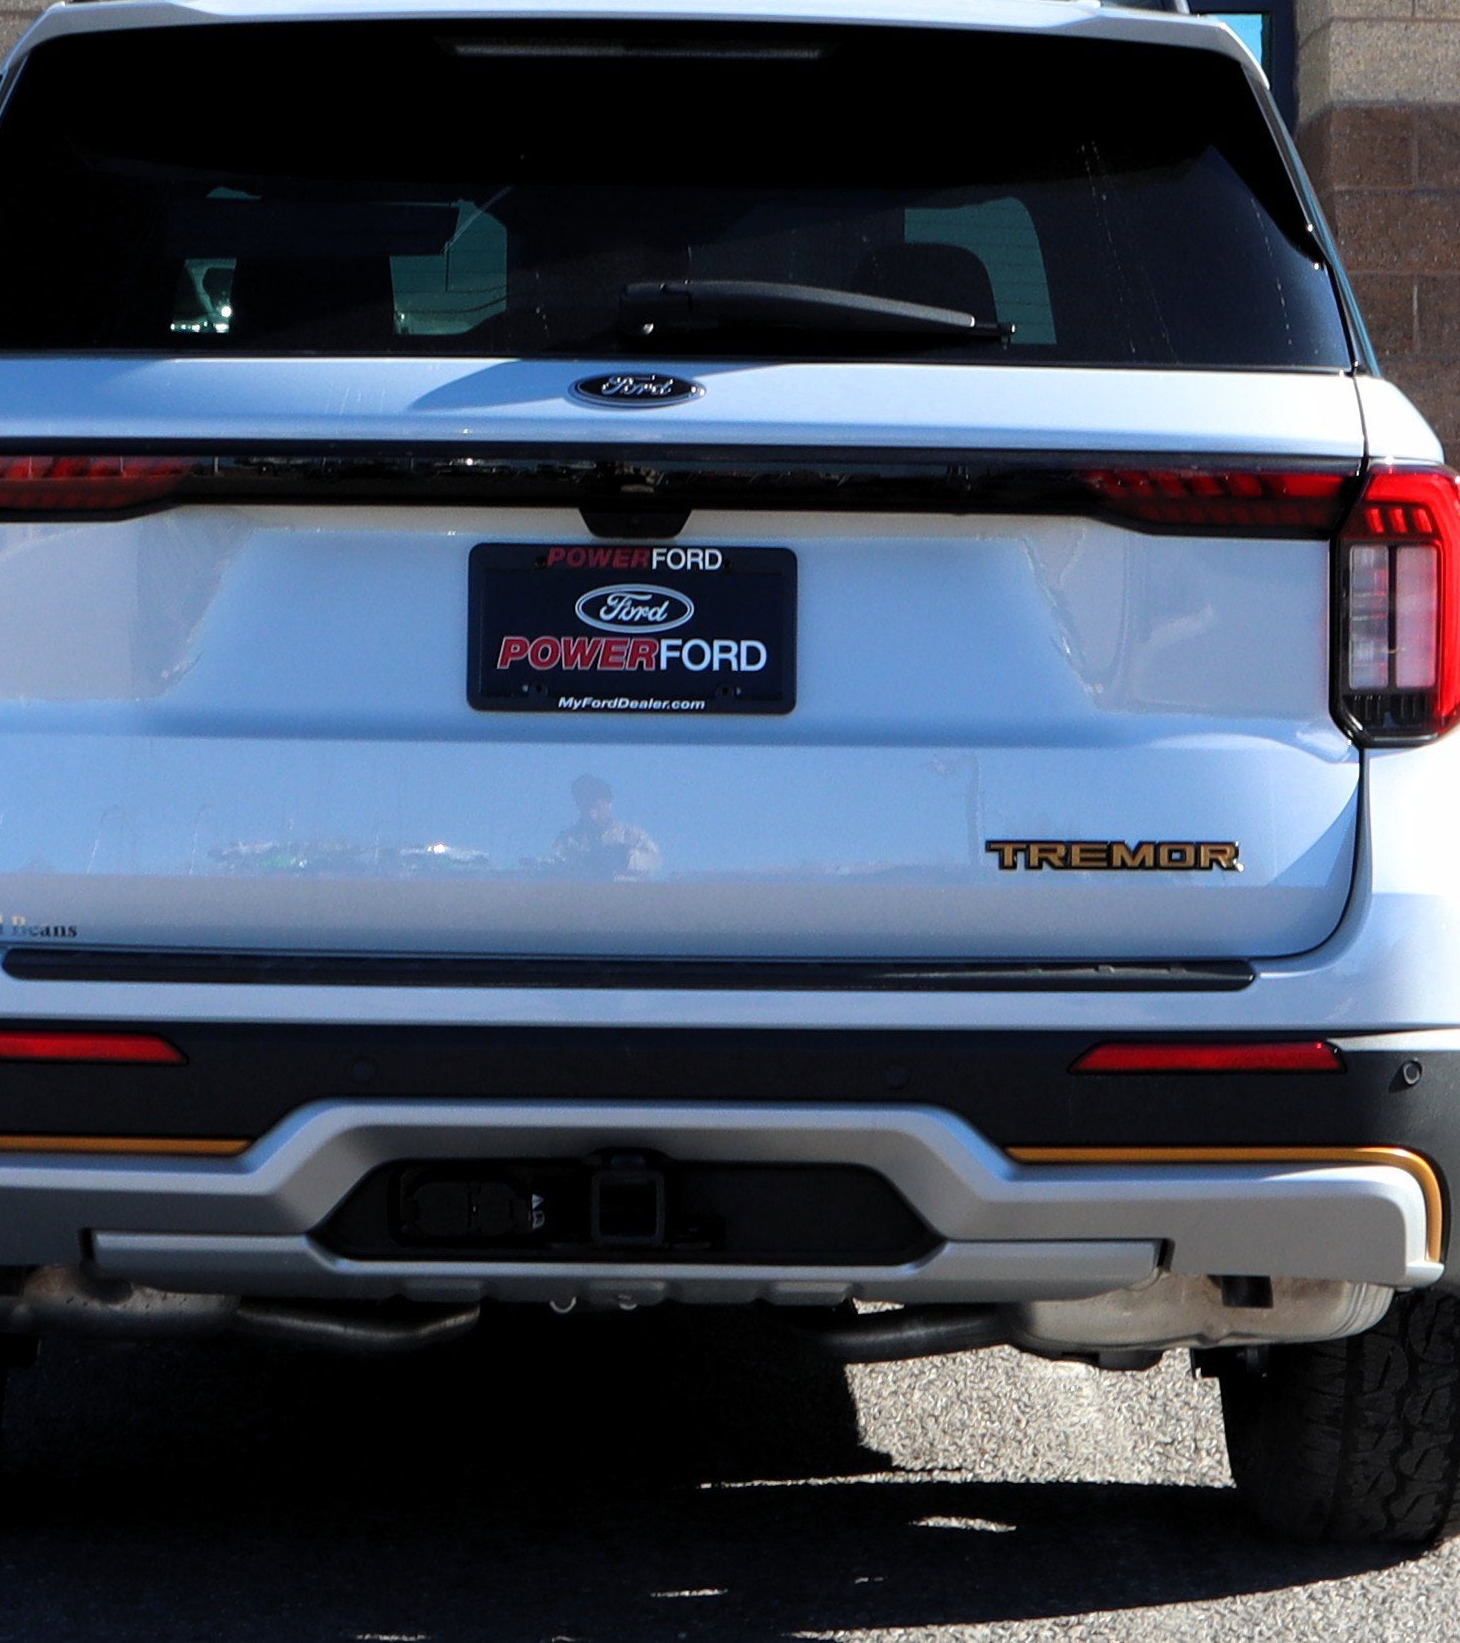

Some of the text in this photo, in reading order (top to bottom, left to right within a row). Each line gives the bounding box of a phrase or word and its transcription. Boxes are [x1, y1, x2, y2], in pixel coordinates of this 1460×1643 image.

[601, 373, 674, 397] Ford
[599, 592, 668, 623] Ford
[557, 695, 706, 711] MyFordDealer.com
[985, 839, 1244, 873] TREMOR
